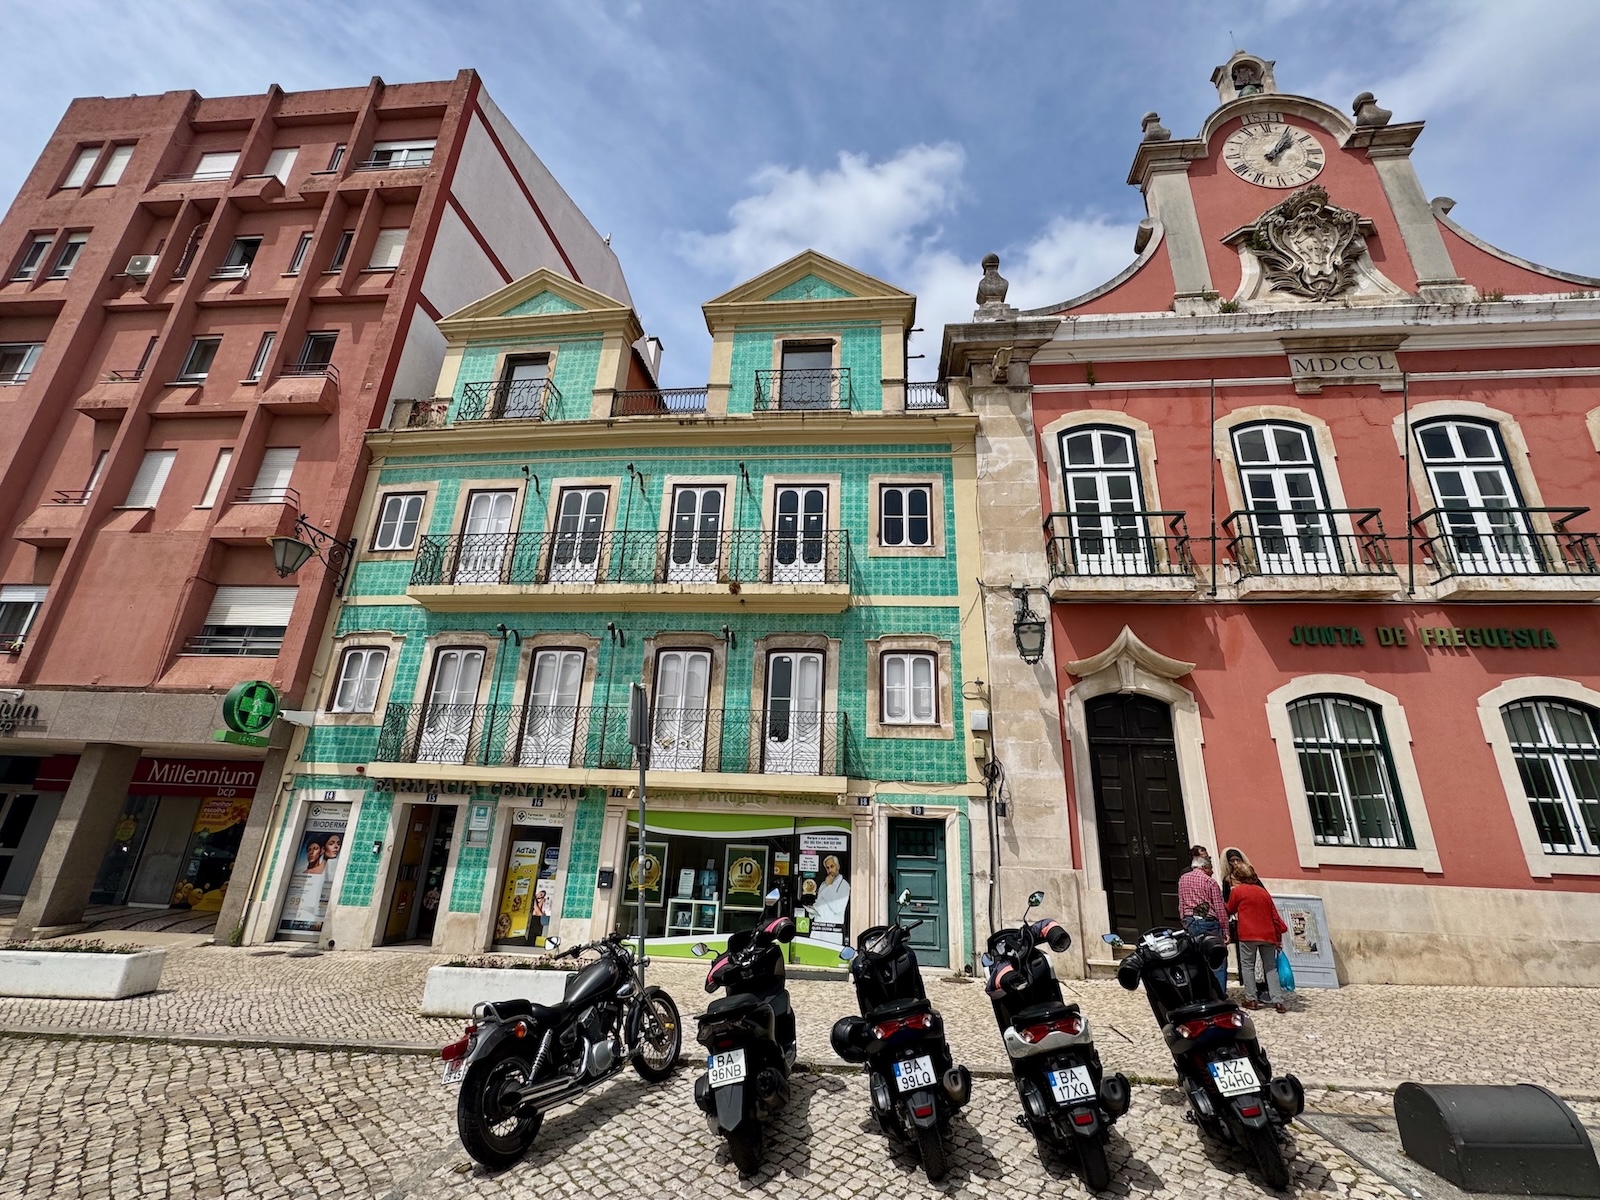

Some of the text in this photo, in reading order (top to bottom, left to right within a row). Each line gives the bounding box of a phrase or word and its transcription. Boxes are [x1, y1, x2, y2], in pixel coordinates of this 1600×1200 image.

[1293, 355, 1395, 373] MDCCL
[1290, 625, 1559, 649] JUNTA DE FREGUESIA
[147, 760, 256, 785] Millennium
[217, 786, 236, 798] bcp
[374, 778, 588, 801] FARMACIA CENTRAL
[614, 788, 622, 797] 17
[427, 794, 436, 802] 15
[860, 797, 868, 805] 18
[914, 806, 922, 815] 19
[515, 846, 537, 854] AdTab
[738, 862, 753, 875] 10
[717, 1053, 734, 1068] BA
[903, 1059, 923, 1075] BA
[1222, 1060, 1242, 1075] AZ
[711, 1064, 742, 1082] 96NB
[901, 1071, 931, 1089] 99LQ
[1058, 1069, 1080, 1085] BA
[1218, 1072, 1255, 1090] 54HO
[1058, 1082, 1090, 1100] 17XQ
